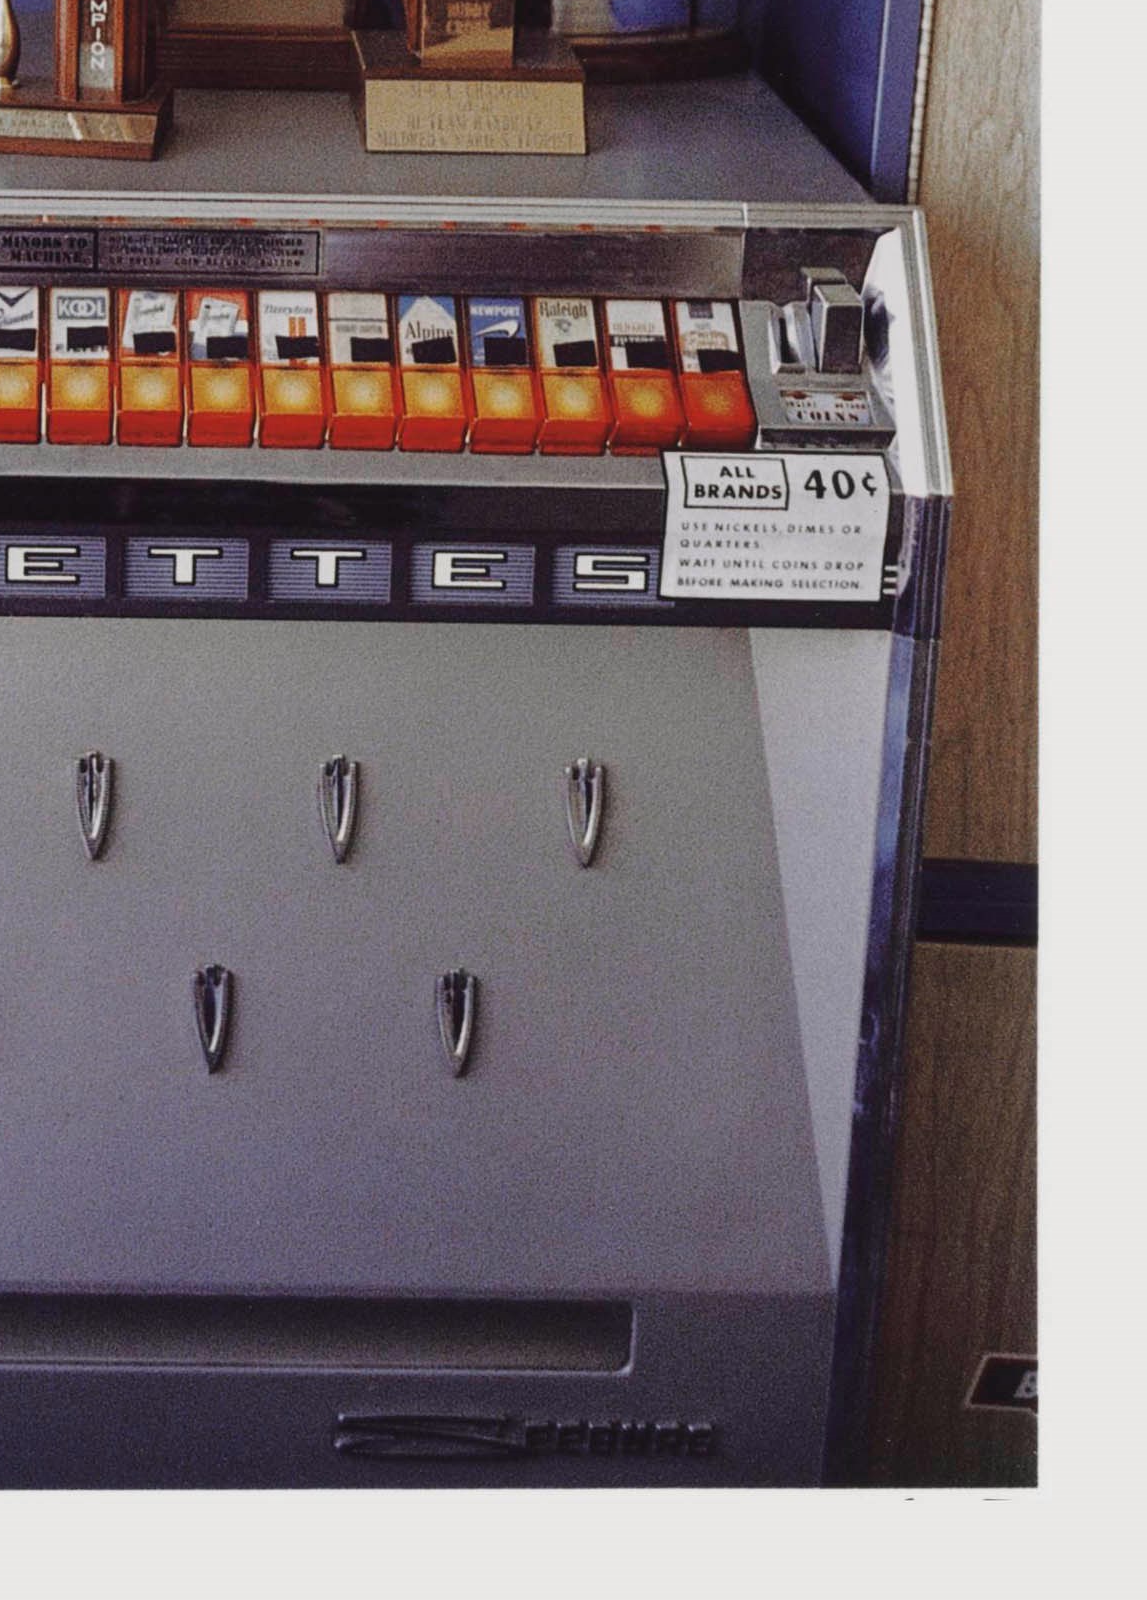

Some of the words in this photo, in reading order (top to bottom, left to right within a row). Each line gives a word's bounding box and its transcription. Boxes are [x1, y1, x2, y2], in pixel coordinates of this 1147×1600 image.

[1, 236, 62, 249] MINORS
[67, 237, 88, 249] TO
[58, 299, 105, 317] KOOL
[470, 305, 521, 317] NEWPORT
[540, 301, 588, 319] Raleigh
[405, 321, 454, 341] Alpine
[795, 410, 860, 422] COINS
[719, 466, 756, 479] ALL
[804, 469, 878, 501] 40¢
[694, 484, 782, 500] BRANDS
[681, 522, 708, 532] USE
[714, 523, 782, 535] NICKELS,
[787, 524, 834, 534] DIMES
[842, 525, 862, 534] OR
[679, 559, 716, 568] WAIT
[722, 560, 764, 569] UNTIL
[772, 561, 818, 570] COINS
[824, 562, 865, 571] DROP
[677, 577, 722, 587] BEFORE
[730, 578, 783, 588] MAKING
[791, 580, 864, 590] SELECTION.
